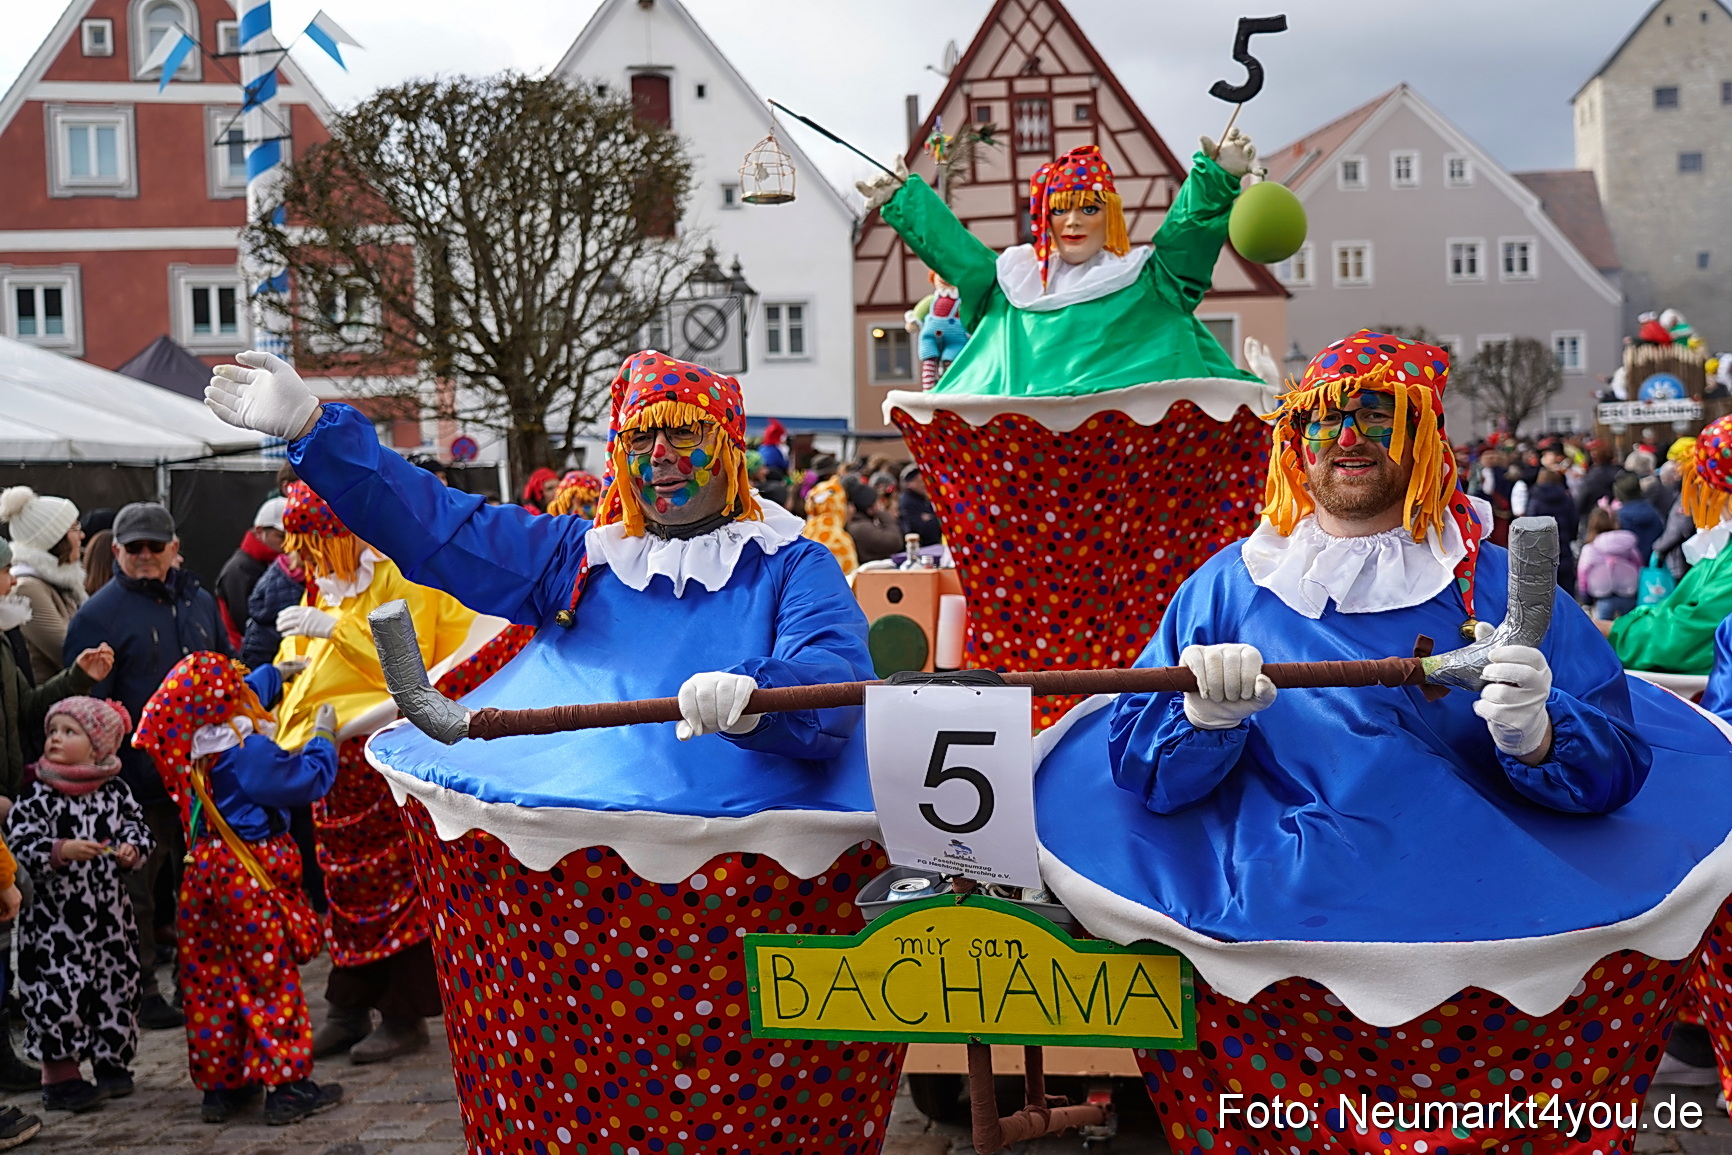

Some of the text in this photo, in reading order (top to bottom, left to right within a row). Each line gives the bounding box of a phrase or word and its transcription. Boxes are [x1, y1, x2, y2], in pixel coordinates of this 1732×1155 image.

[1208, 14, 1288, 103] 5
[918, 730, 997, 834] 5
[929, 860, 963, 872] Hechtonia
[965, 868, 996, 879] Berching
[933, 857, 992, 872] Faschingsumzug
[894, 925, 1028, 960] mir san
[770, 953, 1179, 1030] BACHAMA
